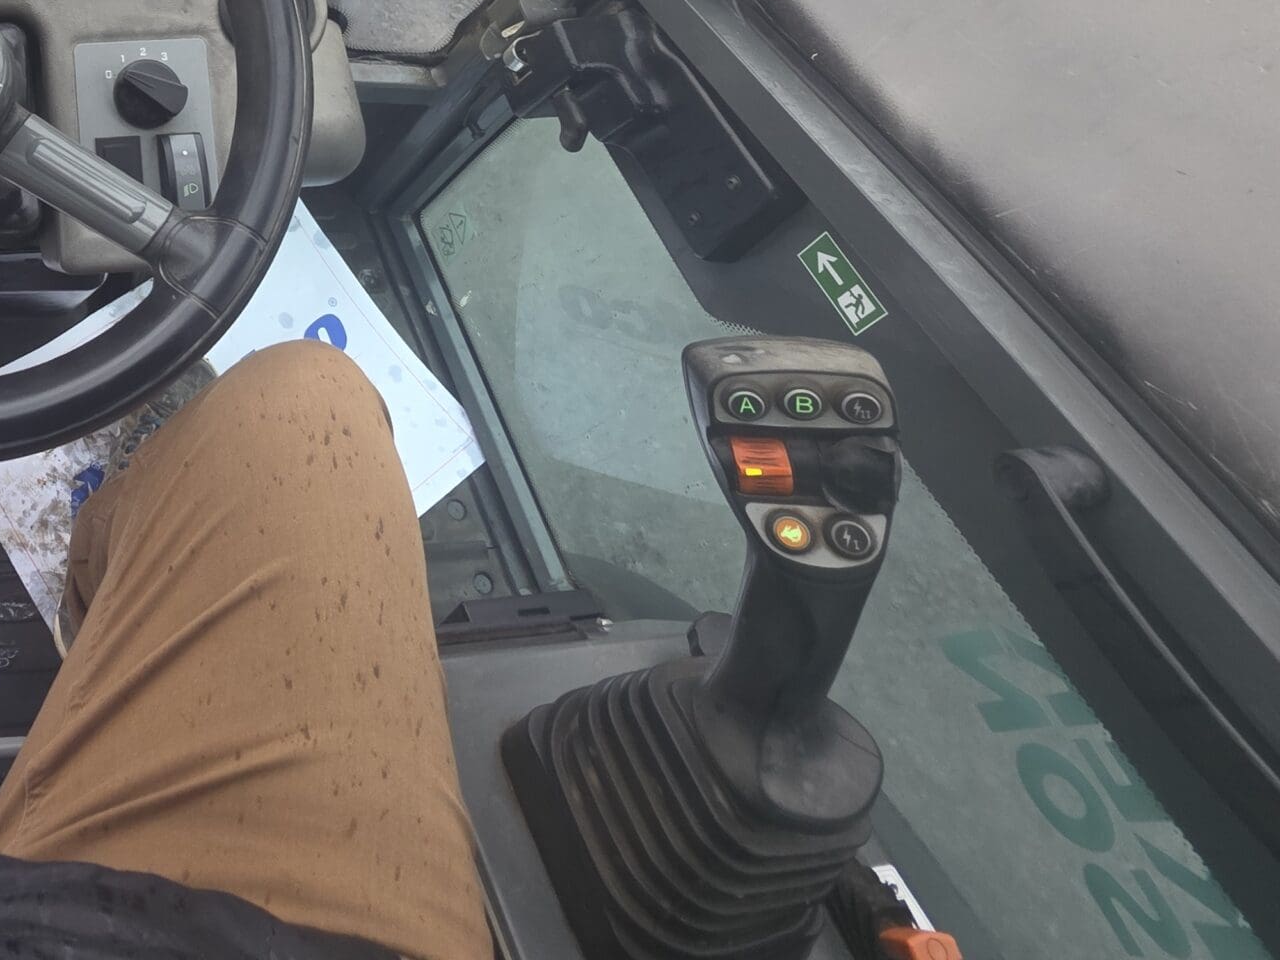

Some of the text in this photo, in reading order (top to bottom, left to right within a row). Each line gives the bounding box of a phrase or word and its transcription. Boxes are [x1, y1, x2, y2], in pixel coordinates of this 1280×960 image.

[105, 47, 168, 79] 0 1 2 3
[739, 398, 756, 414] A
[795, 397, 814, 414] B
